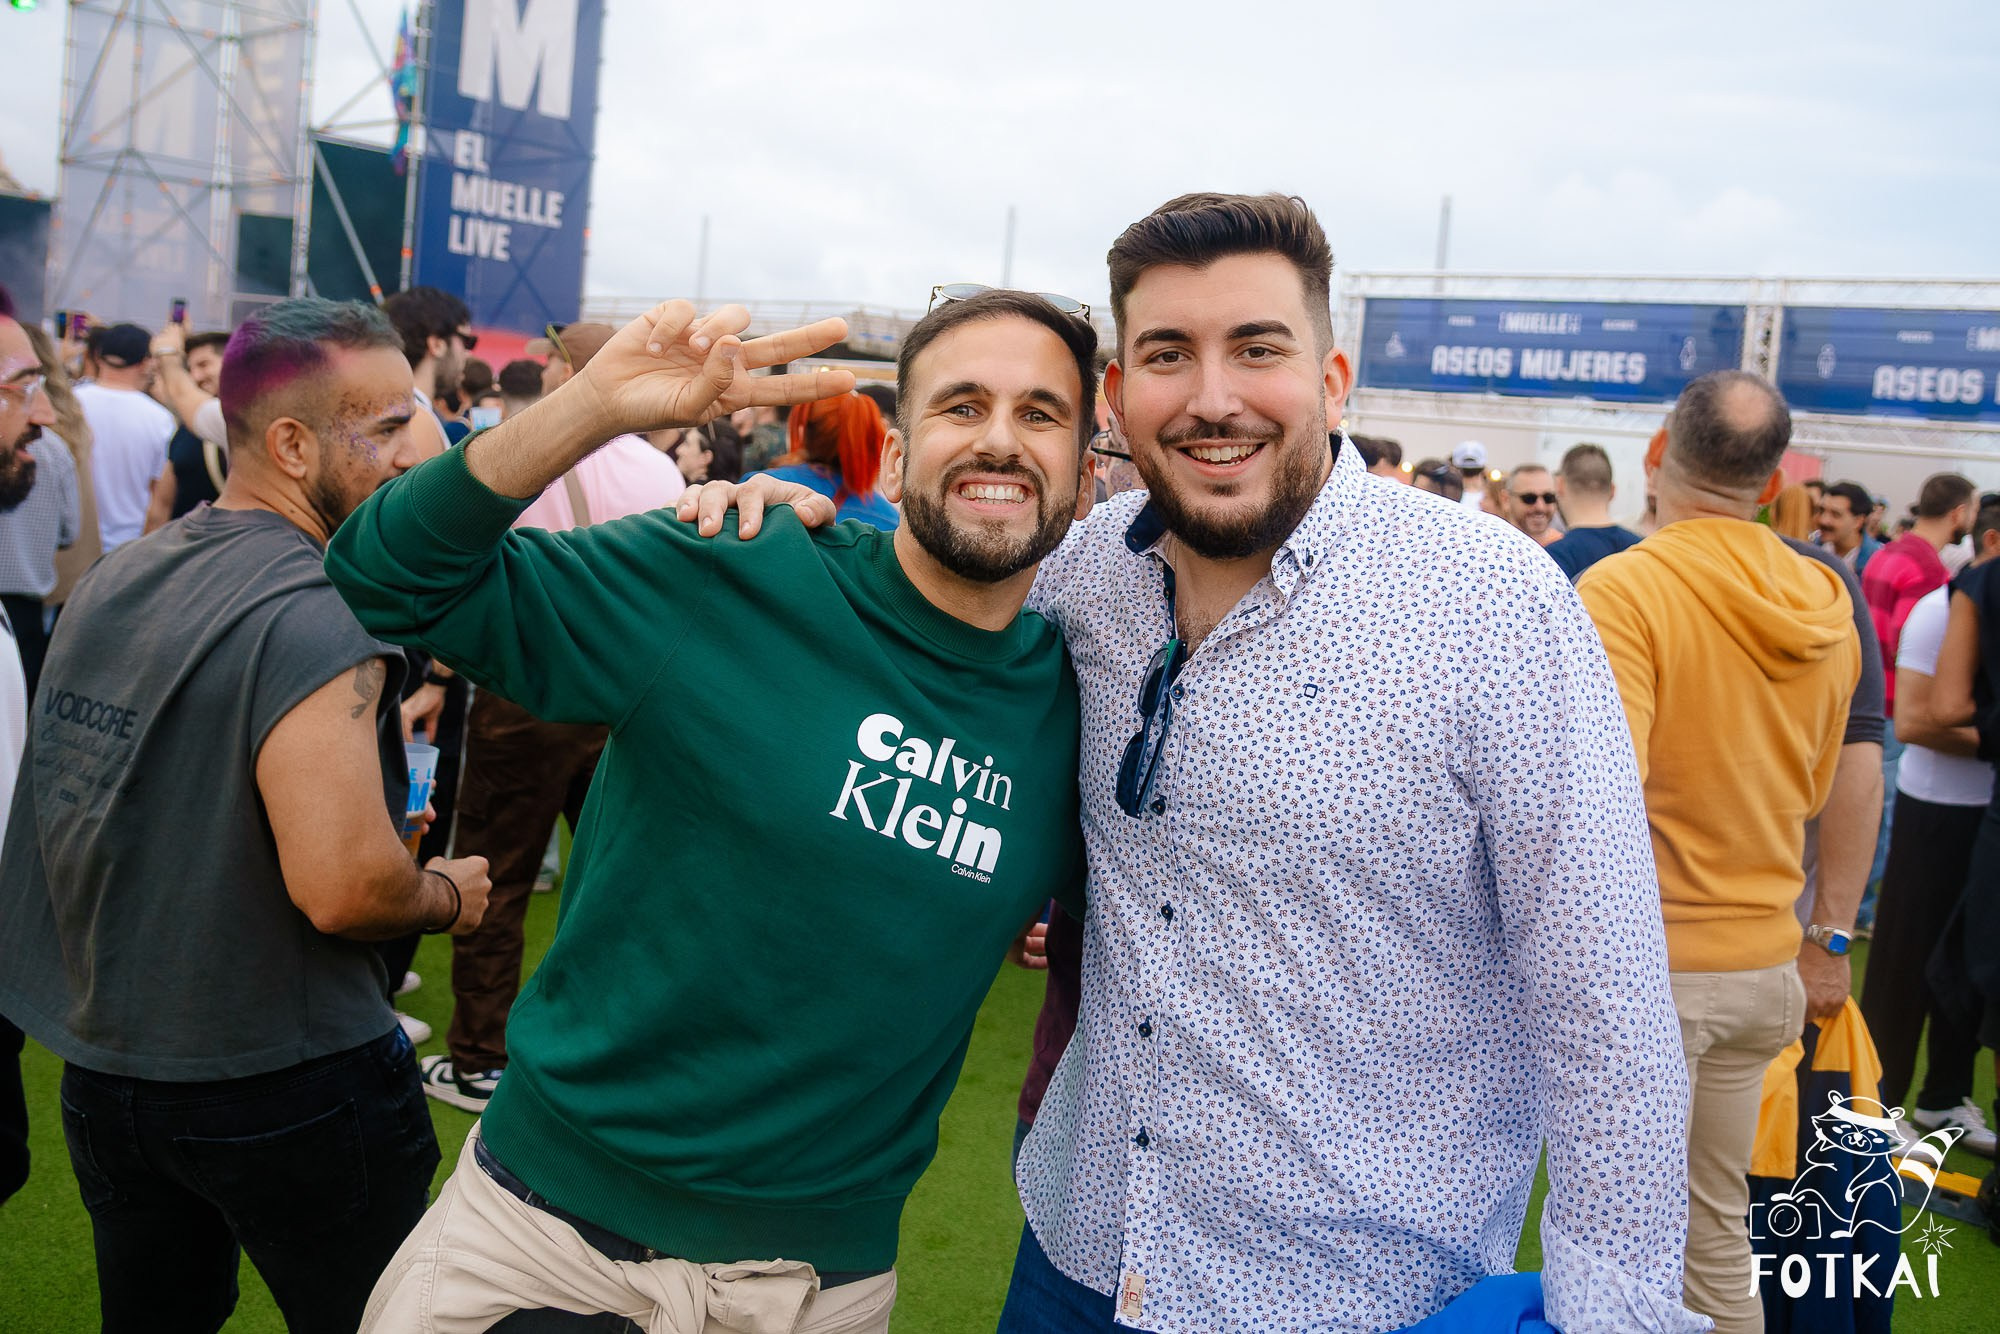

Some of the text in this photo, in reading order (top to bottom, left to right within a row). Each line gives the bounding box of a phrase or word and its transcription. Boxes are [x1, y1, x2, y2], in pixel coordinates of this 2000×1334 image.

[457, 0, 579, 121] M
[454, 128, 489, 173] EL
[450, 172, 564, 229] MUELLE
[448, 214, 511, 263] LIVE
[1505, 312, 1569, 335] MUELLE
[1431, 345, 1648, 384] ASEOS MUJERES
[1872, 365, 1985, 405] ASEOS
[44, 686, 138, 740] VOIDCORE
[856, 712, 1013, 811] Calvin
[828, 759, 1002, 874] Klein
[951, 863, 991, 884] Calvin Klein
